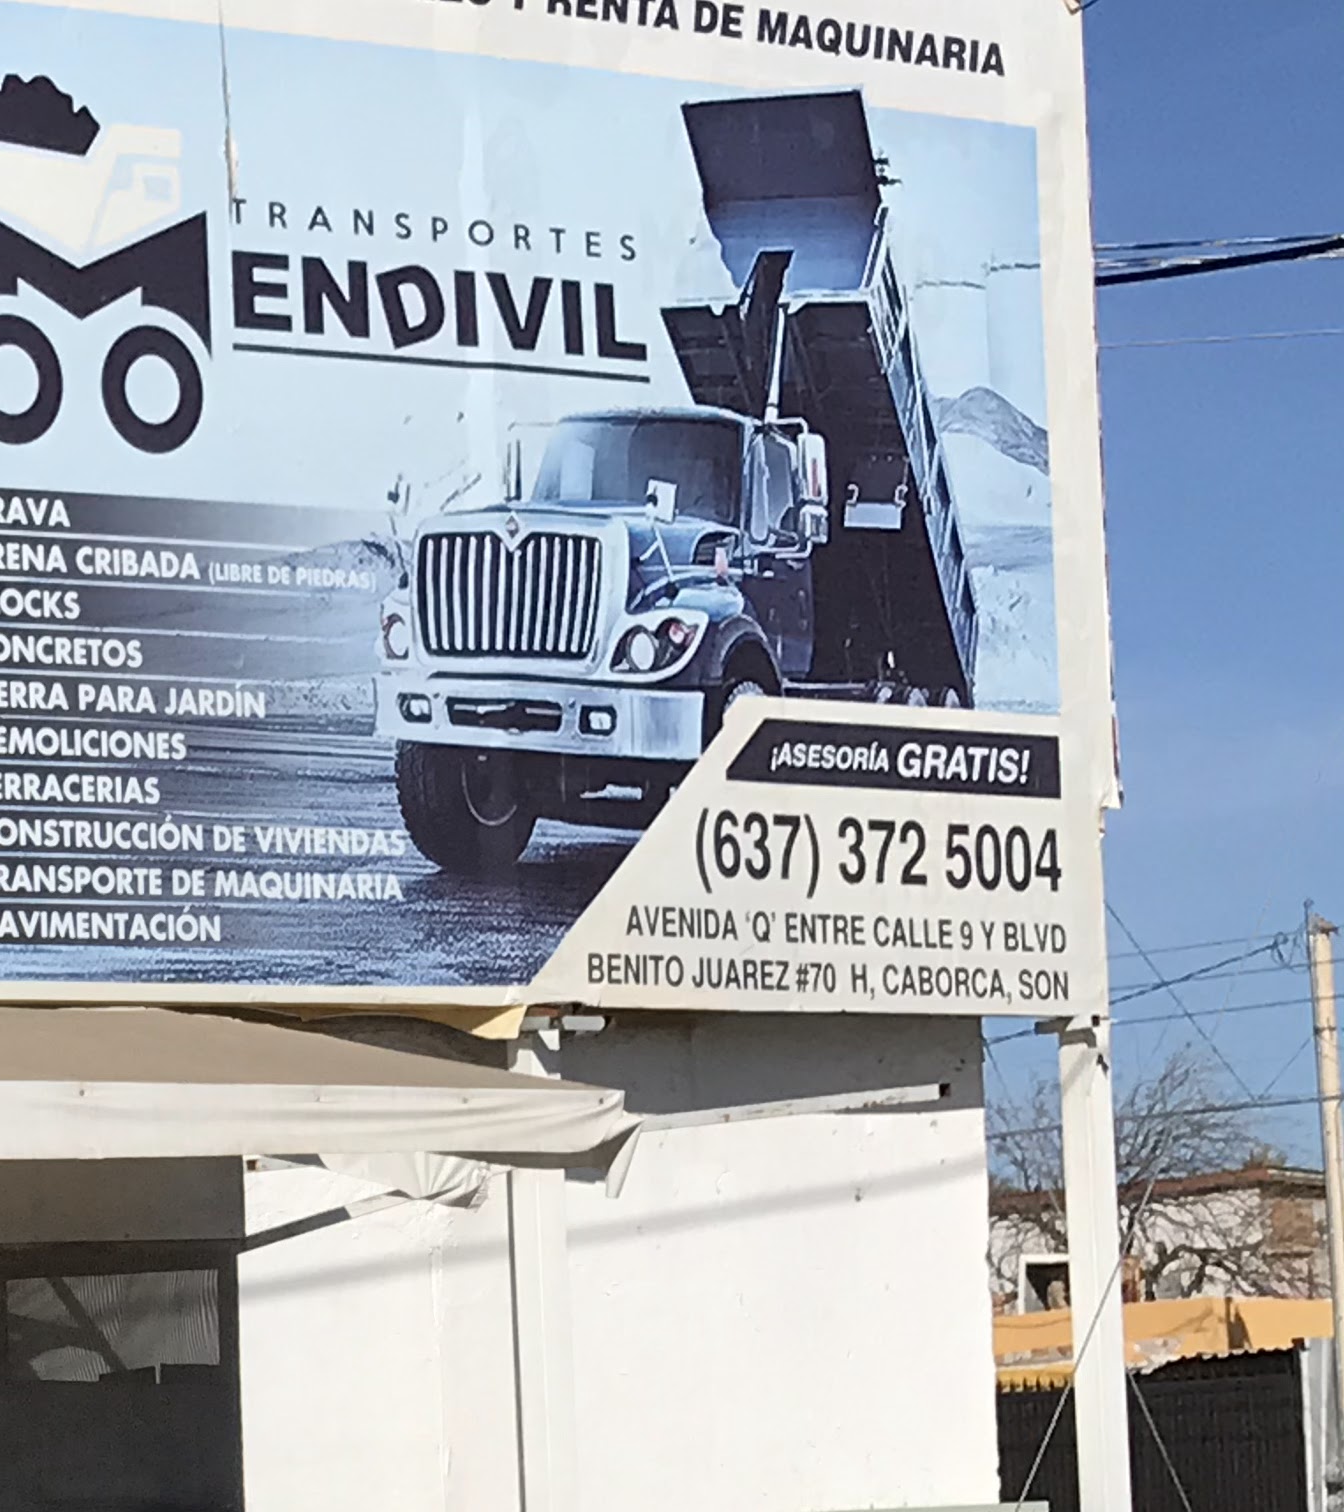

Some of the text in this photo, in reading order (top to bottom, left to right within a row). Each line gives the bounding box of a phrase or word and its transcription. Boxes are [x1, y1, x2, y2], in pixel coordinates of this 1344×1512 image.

[694, 0, 743, 38] DE
[757, 9, 1005, 76] MAQUINARIA
[232, 199, 638, 262] TRANSPORTES
[76, 546, 200, 580] CRIBADA
[208, 562, 263, 585] (LIBRE
[268, 566, 291, 586] DE
[295, 567, 377, 592] PIEDRAS)
[78, 685, 156, 714] PARA
[165, 682, 265, 719] JARDÍN
[770, 740, 1031, 785] ¡ASESORÍA GRATIS!
[213, 827, 245, 853] DE
[254, 828, 406, 857] VIVIENDAS
[696, 807, 1062, 899] (637) 372 5004
[172, 869, 205, 897] DE
[215, 871, 404, 901] MAQUINARIA
[626, 906, 739, 941] AVENIDA
[786, 913, 865, 946] ENTRE
[873, 917, 953, 950] CALLE
[960, 921, 974, 951] 9
[981, 922, 999, 951] Y
[1004, 923, 1067, 953] BLVD
[587, 953, 684, 986] BENITO
[691, 957, 790, 991] JUAREZ
[795, 961, 837, 992] #70
[883, 966, 1012, 1004] CABORCA,
[1019, 970, 1069, 1000] SON
